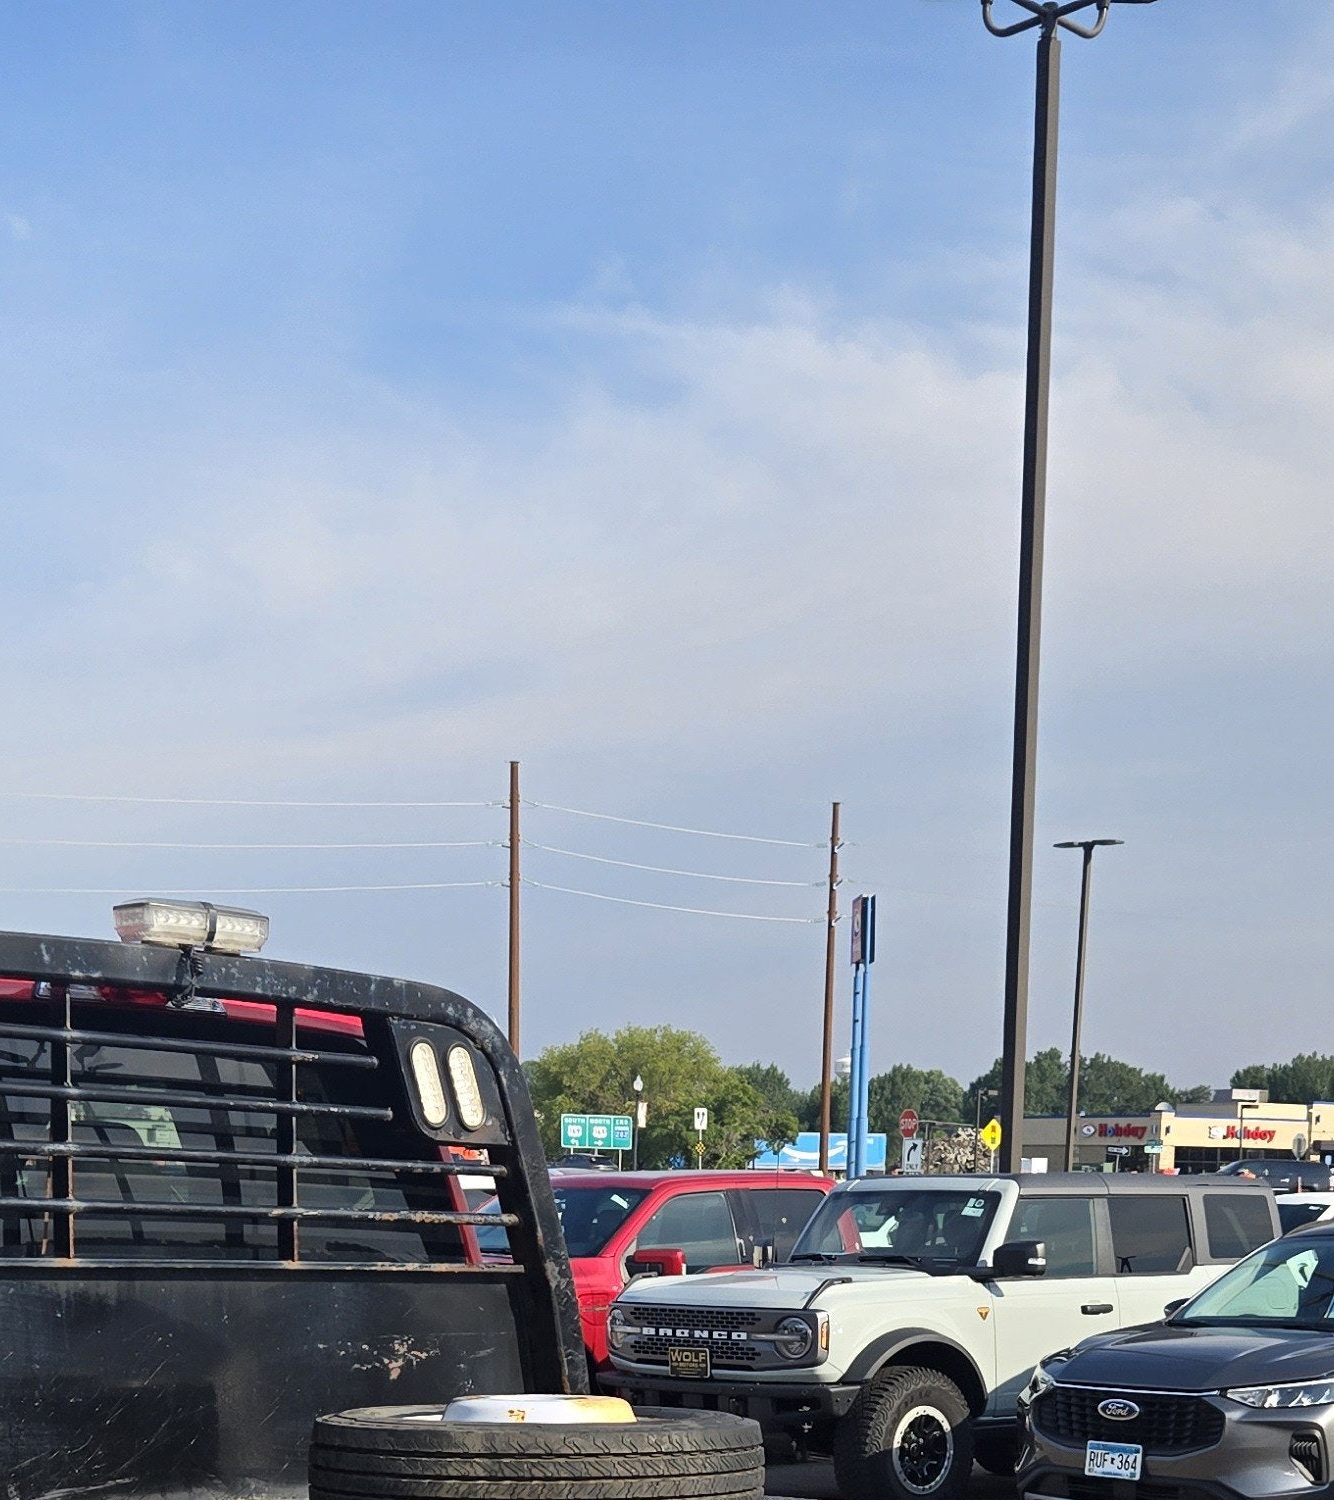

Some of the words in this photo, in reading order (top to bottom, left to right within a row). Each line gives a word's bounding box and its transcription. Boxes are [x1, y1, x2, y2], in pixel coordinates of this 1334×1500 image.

[900, 1119, 917, 1130] STOP
[1098, 1123, 1147, 1140] Holiday
[642, 1327, 747, 1340] BRONCO
[671, 1349, 706, 1362] WOLF
[1106, 1403, 1129, 1416] Ford
[1089, 1451, 1109, 1469] RUF
[1117, 1453, 1138, 1471] 364
